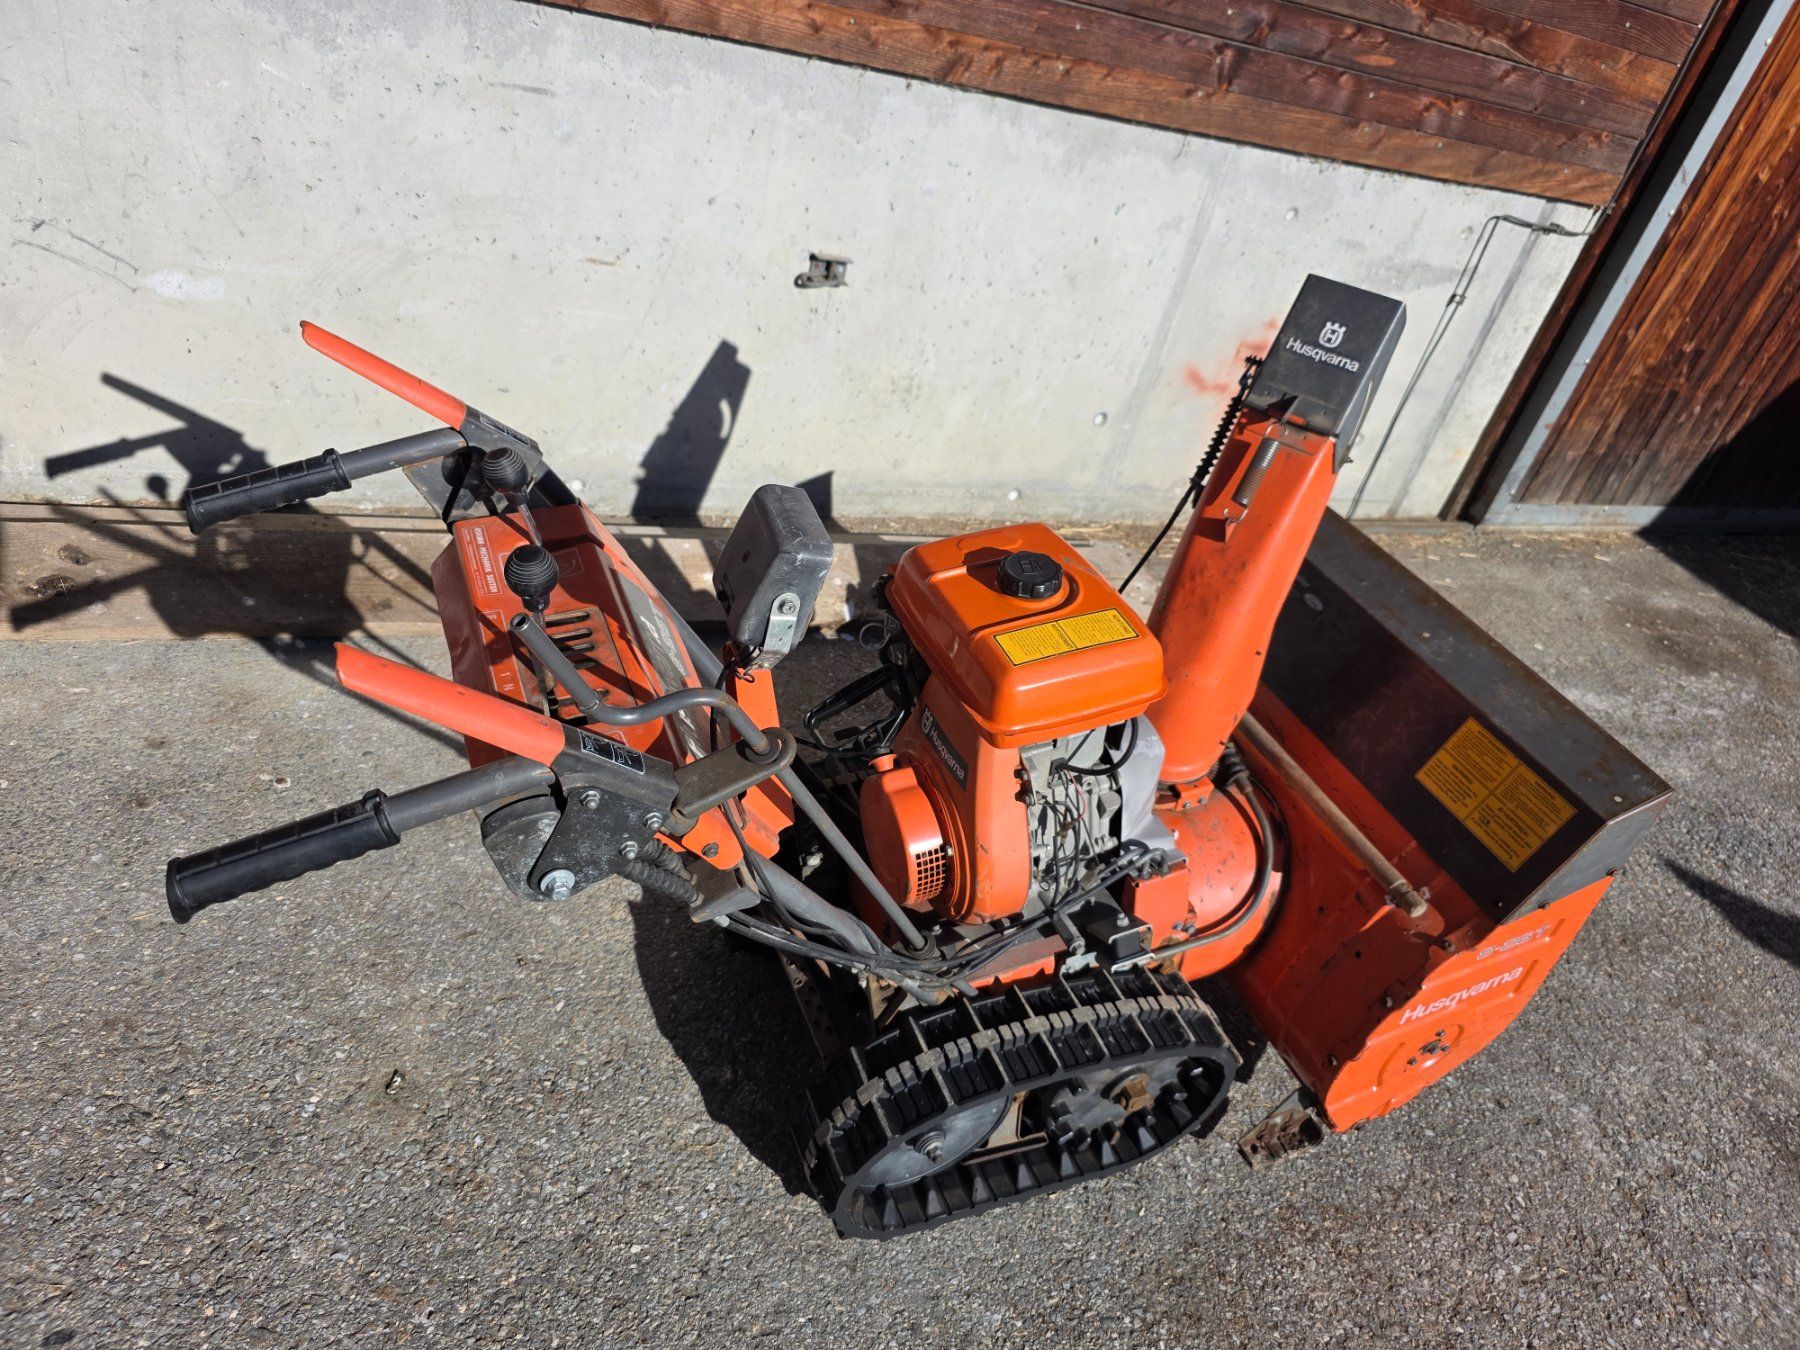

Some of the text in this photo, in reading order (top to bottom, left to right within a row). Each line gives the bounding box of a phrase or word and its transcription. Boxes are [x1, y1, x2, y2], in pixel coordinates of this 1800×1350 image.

[1286, 337, 1360, 372] Husqvarna
[929, 726, 965, 780] Husqvarna
[1399, 966, 1524, 1025] Husqvarna
